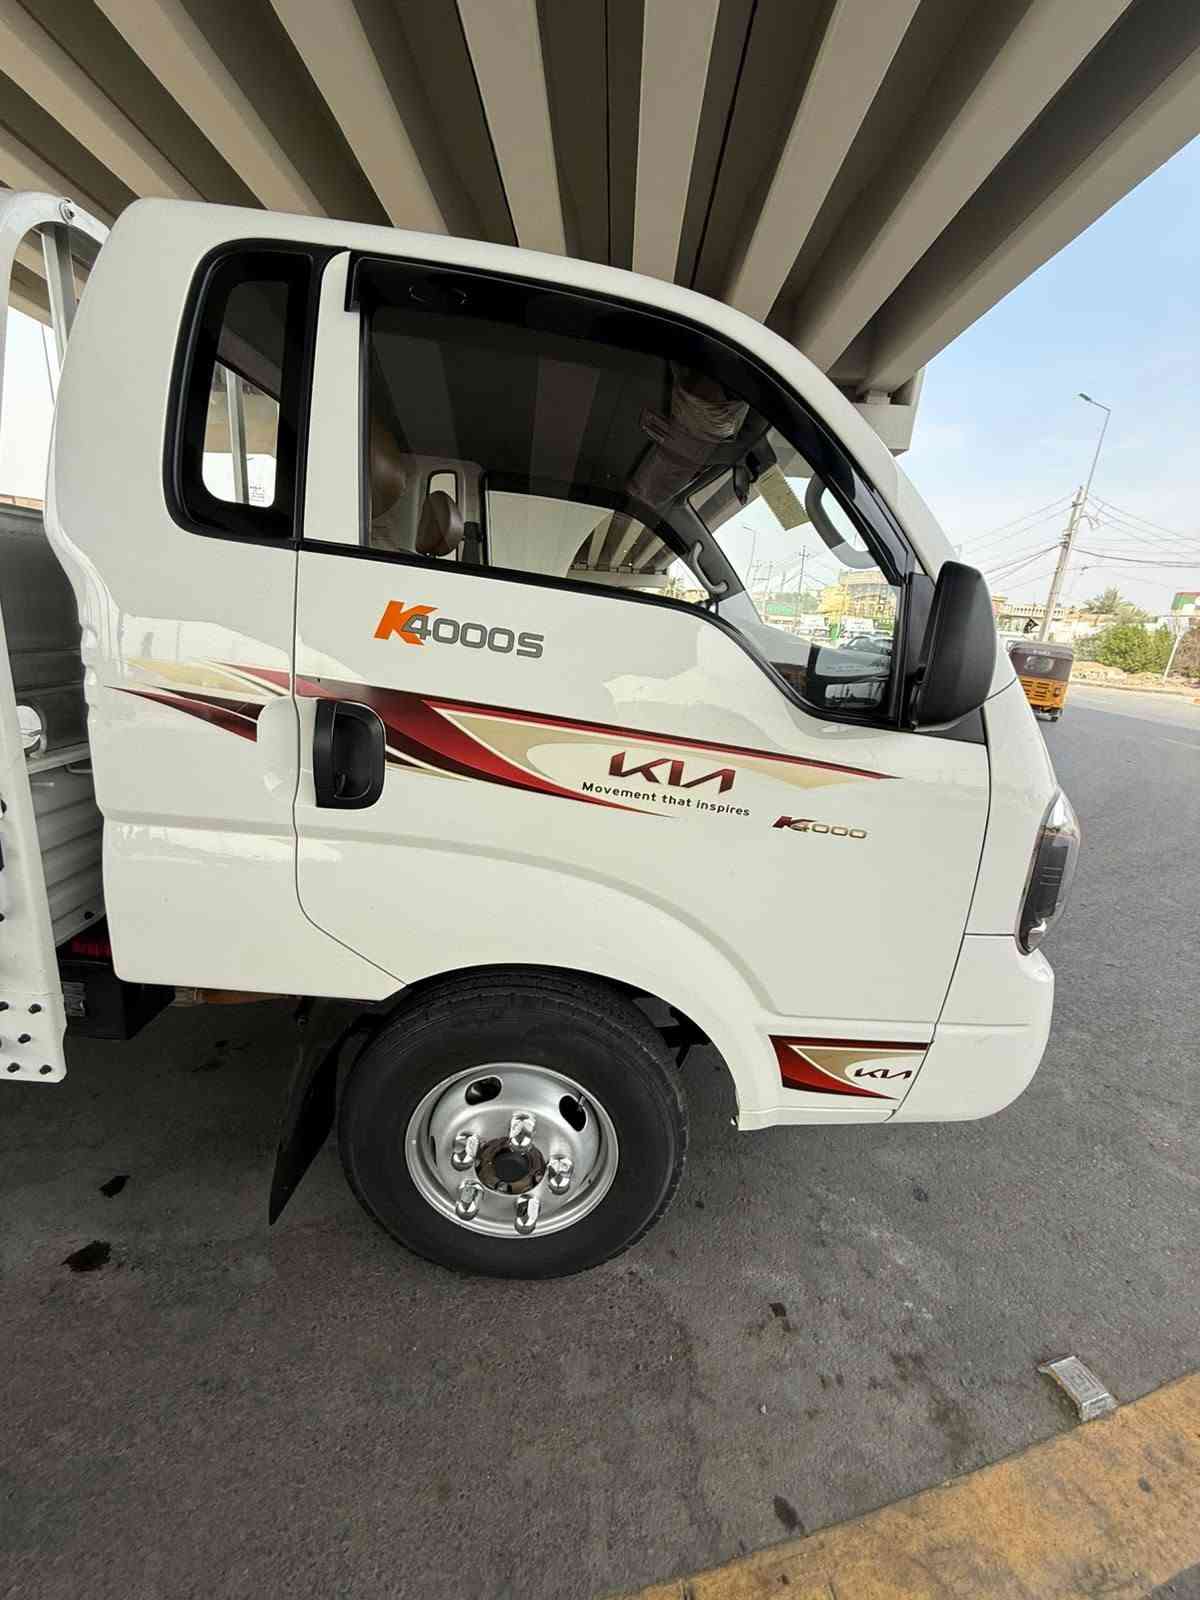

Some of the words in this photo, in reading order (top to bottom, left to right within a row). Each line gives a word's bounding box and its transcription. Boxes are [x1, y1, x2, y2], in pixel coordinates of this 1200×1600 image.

[373, 600, 545, 659] K4000S
[608, 751, 736, 794] KIA
[582, 781, 657, 802] Movement
[662, 794, 691, 807] that
[695, 800, 751, 816] inspires
[772, 815, 867, 839] K4000
[854, 1068, 913, 1080] KIA
